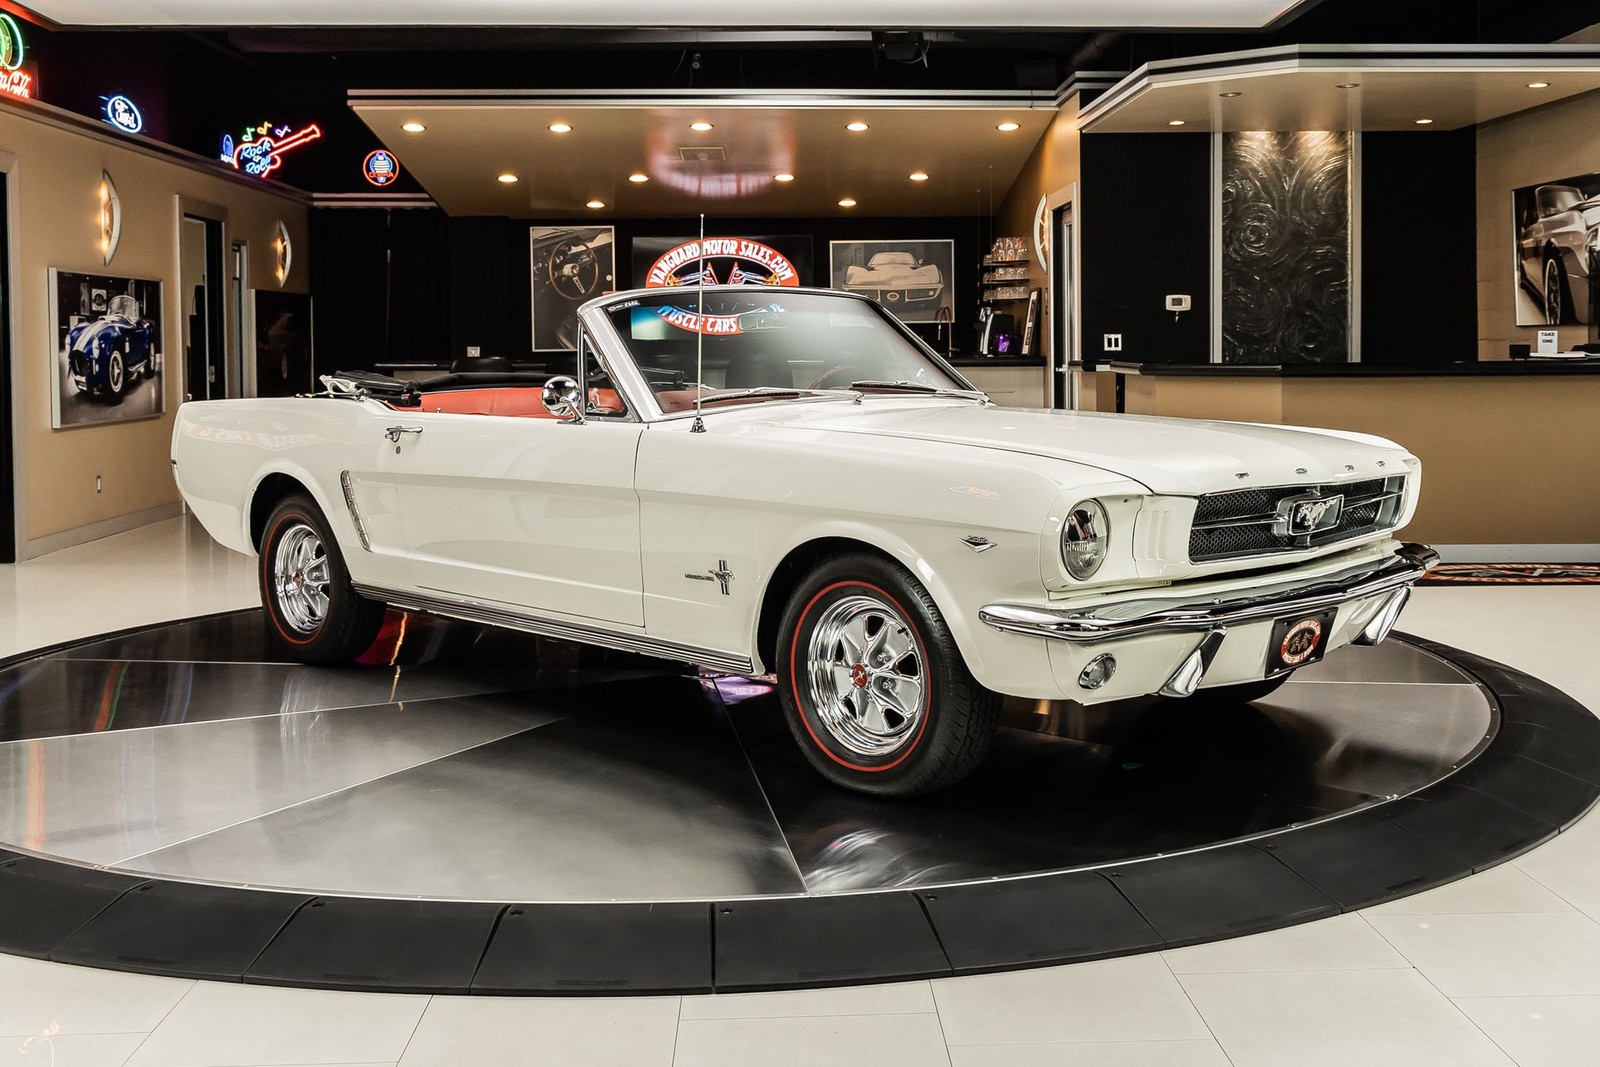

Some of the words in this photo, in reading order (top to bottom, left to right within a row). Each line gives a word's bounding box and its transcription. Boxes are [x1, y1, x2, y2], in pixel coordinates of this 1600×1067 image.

[114, 99, 136, 128] Ford
[240, 139, 271, 160] Rock
[245, 155, 271, 174] Roll
[649, 242, 701, 284] VANGUARD
[702, 239, 738, 256] MOTOR
[738, 240, 795, 280] SALES.COM
[656, 305, 705, 330] MUSCLE
[706, 317, 738, 333] CARS
